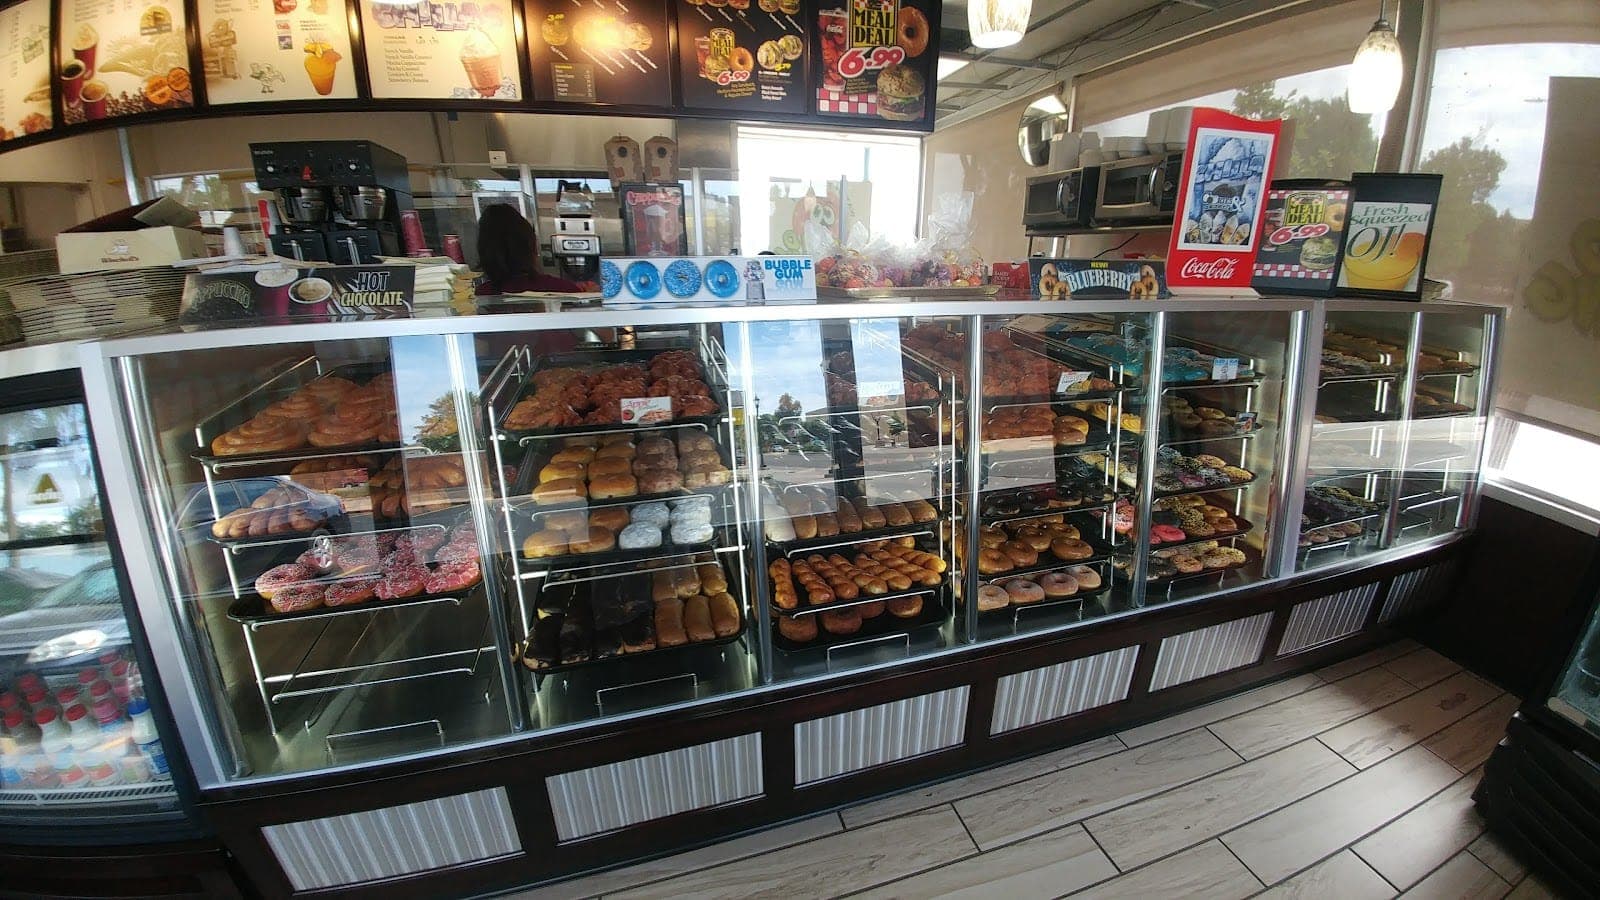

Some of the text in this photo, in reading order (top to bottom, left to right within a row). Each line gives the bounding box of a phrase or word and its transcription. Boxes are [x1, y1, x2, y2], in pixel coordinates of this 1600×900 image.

[854, 8, 895, 26] MEAL
[854, 26, 895, 47] DEAL
[838, 46, 905, 78] 6.99
[717, 70, 750, 86] 6.99
[1350, 212, 1429, 226] Squeezed
[1363, 204, 1409, 217] Fresh
[1270, 223, 1330, 246] 6.99
[1347, 223, 1408, 262] OJ!
[764, 259, 812, 270] BUBBLE
[774, 268, 803, 280] GUM
[1181, 257, 1240, 280] Coca-Cola
[356, 271, 391, 292] HOT
[1066, 269, 1134, 293] BLUEBERRY
[341, 291, 404, 307] CHOCOLATE
